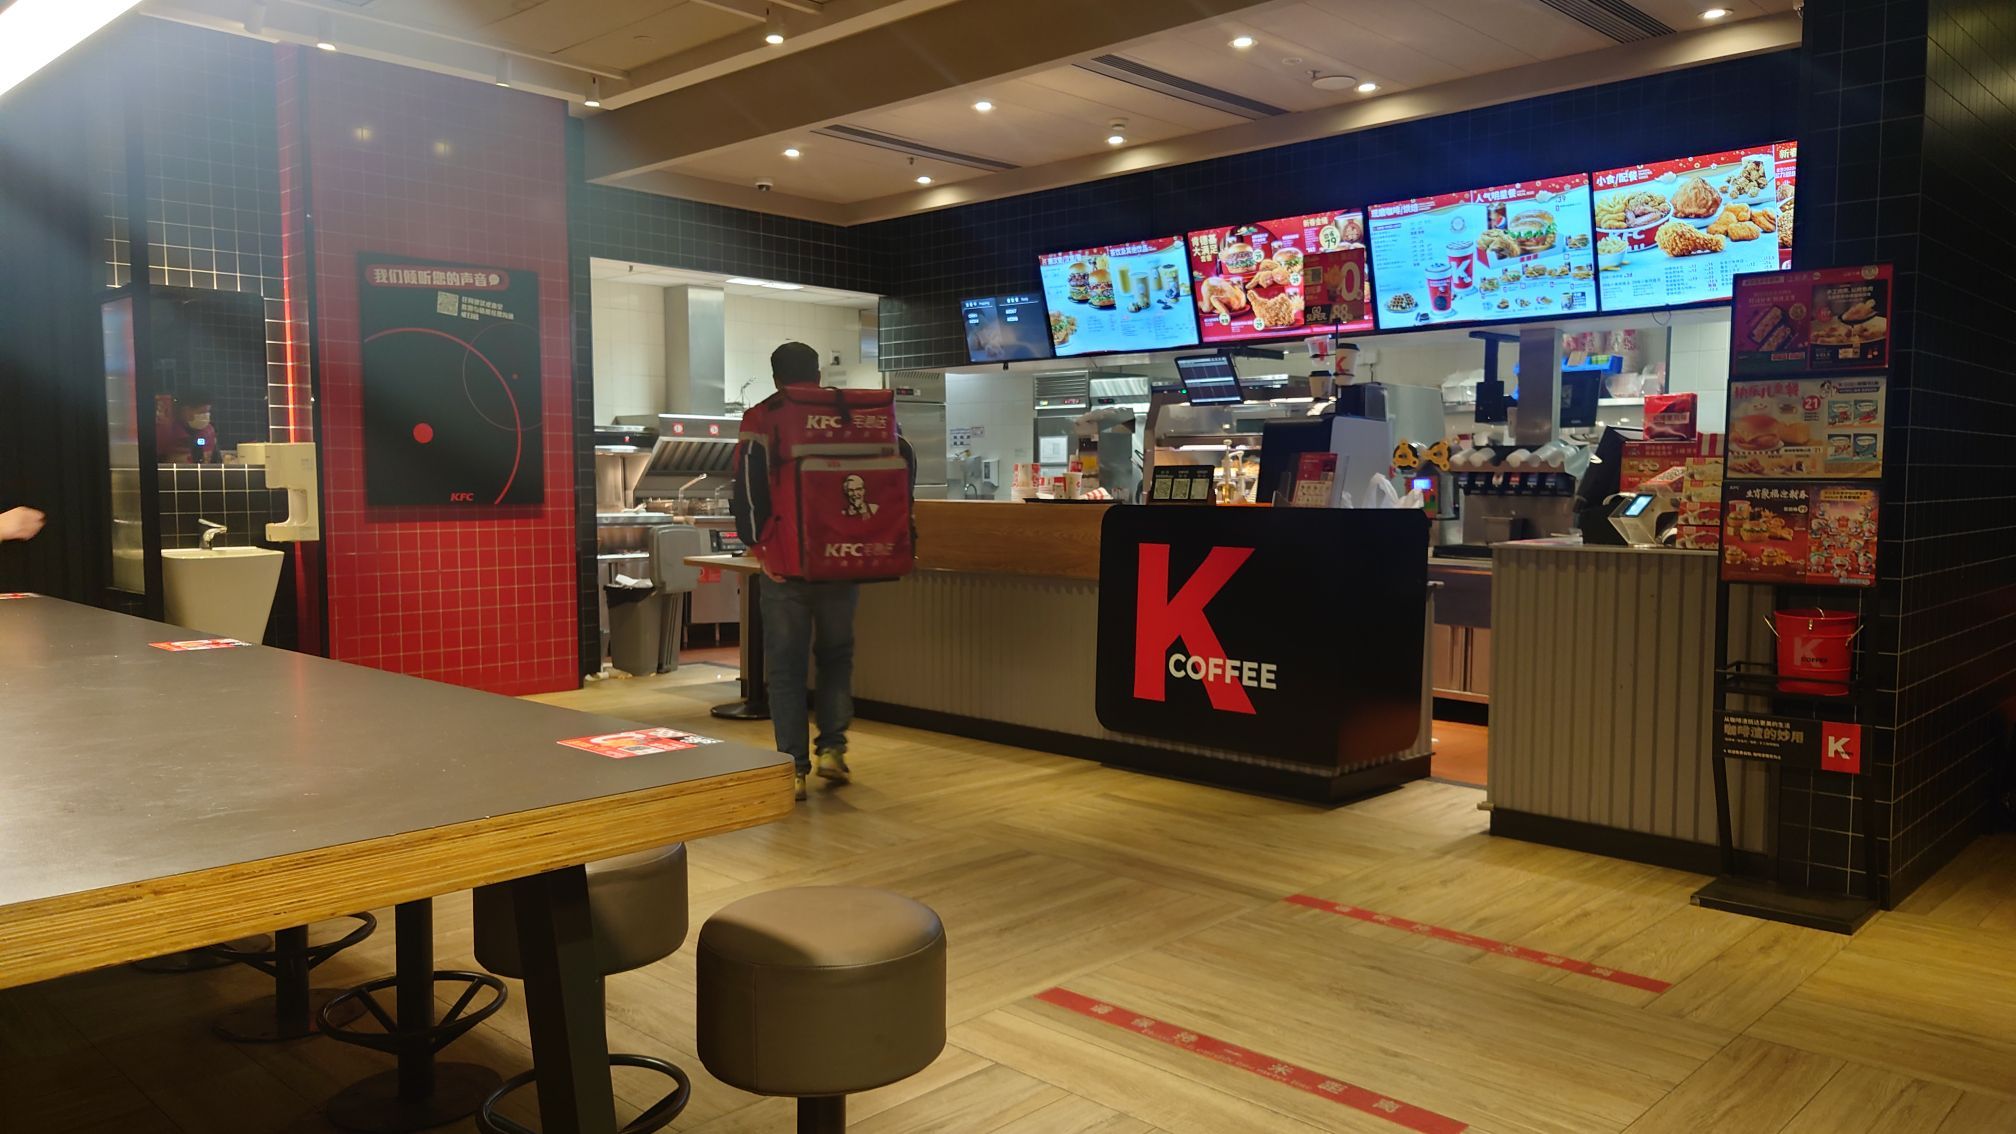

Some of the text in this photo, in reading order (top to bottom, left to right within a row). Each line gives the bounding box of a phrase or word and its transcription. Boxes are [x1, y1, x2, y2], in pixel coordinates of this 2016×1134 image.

[1596, 170, 1638, 187] 小食/配餐
[1475, 188, 1516, 203] 人气明星餐
[1325, 237, 1337, 249] 79
[374, 268, 487, 287] 我们倾听您的声音
[1805, 399, 1819, 409] 21
[806, 415, 842, 429] KFC
[450, 492, 474, 502] KFC
[824, 542, 864, 557] KFC
[1133, 542, 1257, 715] K
[1793, 636, 1824, 668] K
[1168, 652, 1277, 690] COFFEE
[1723, 722, 1805, 744] 咖啡渣的妙用
[1828, 735, 1851, 760] K
